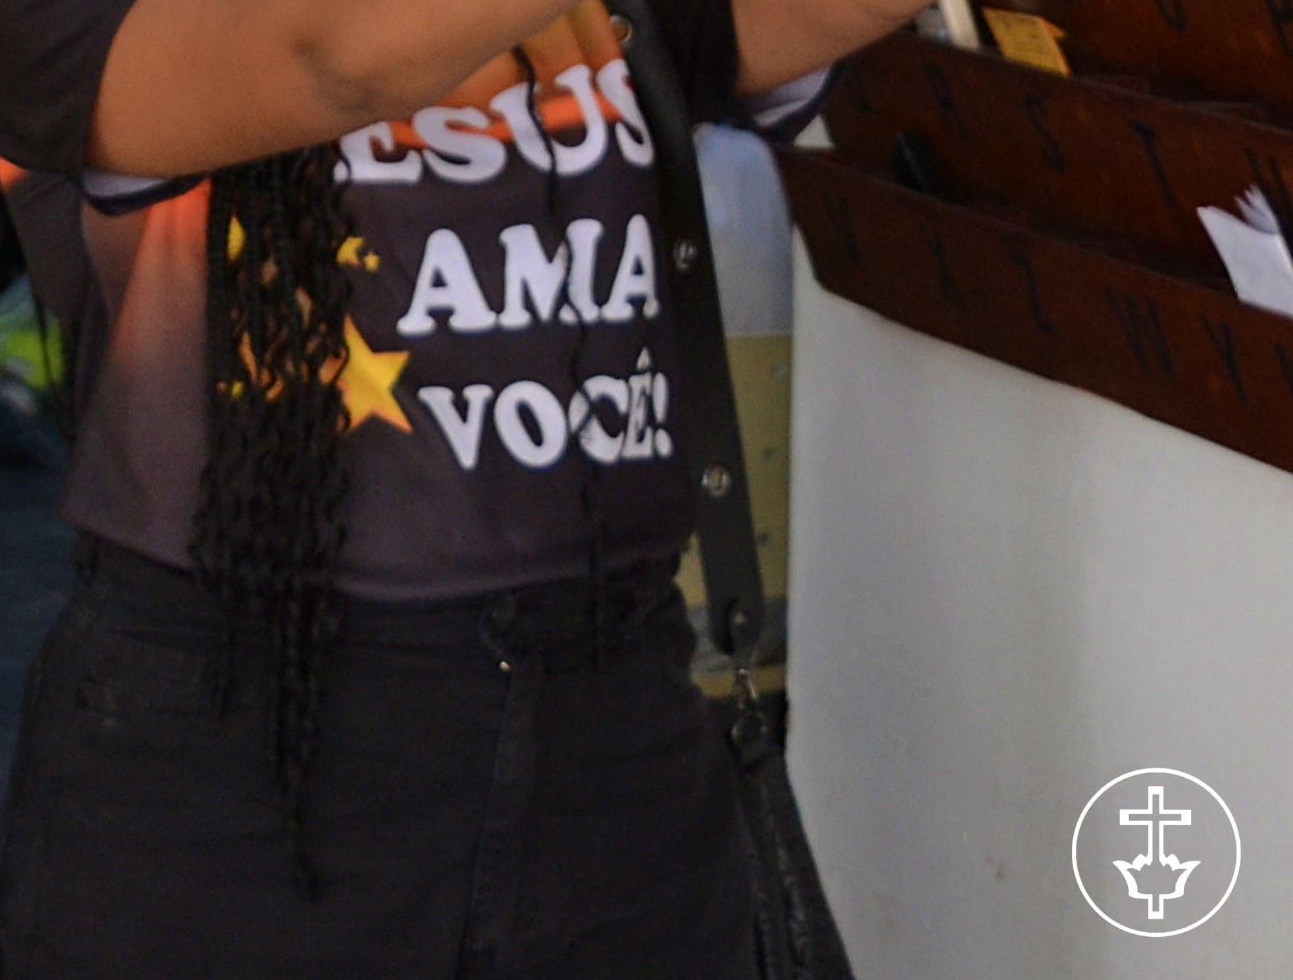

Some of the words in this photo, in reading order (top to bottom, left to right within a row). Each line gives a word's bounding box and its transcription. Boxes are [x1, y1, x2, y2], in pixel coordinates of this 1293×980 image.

[333, 59, 655, 183] ESUS
[396, 214, 661, 336] AMA
[417, 346, 673, 470] VOCÊ!
